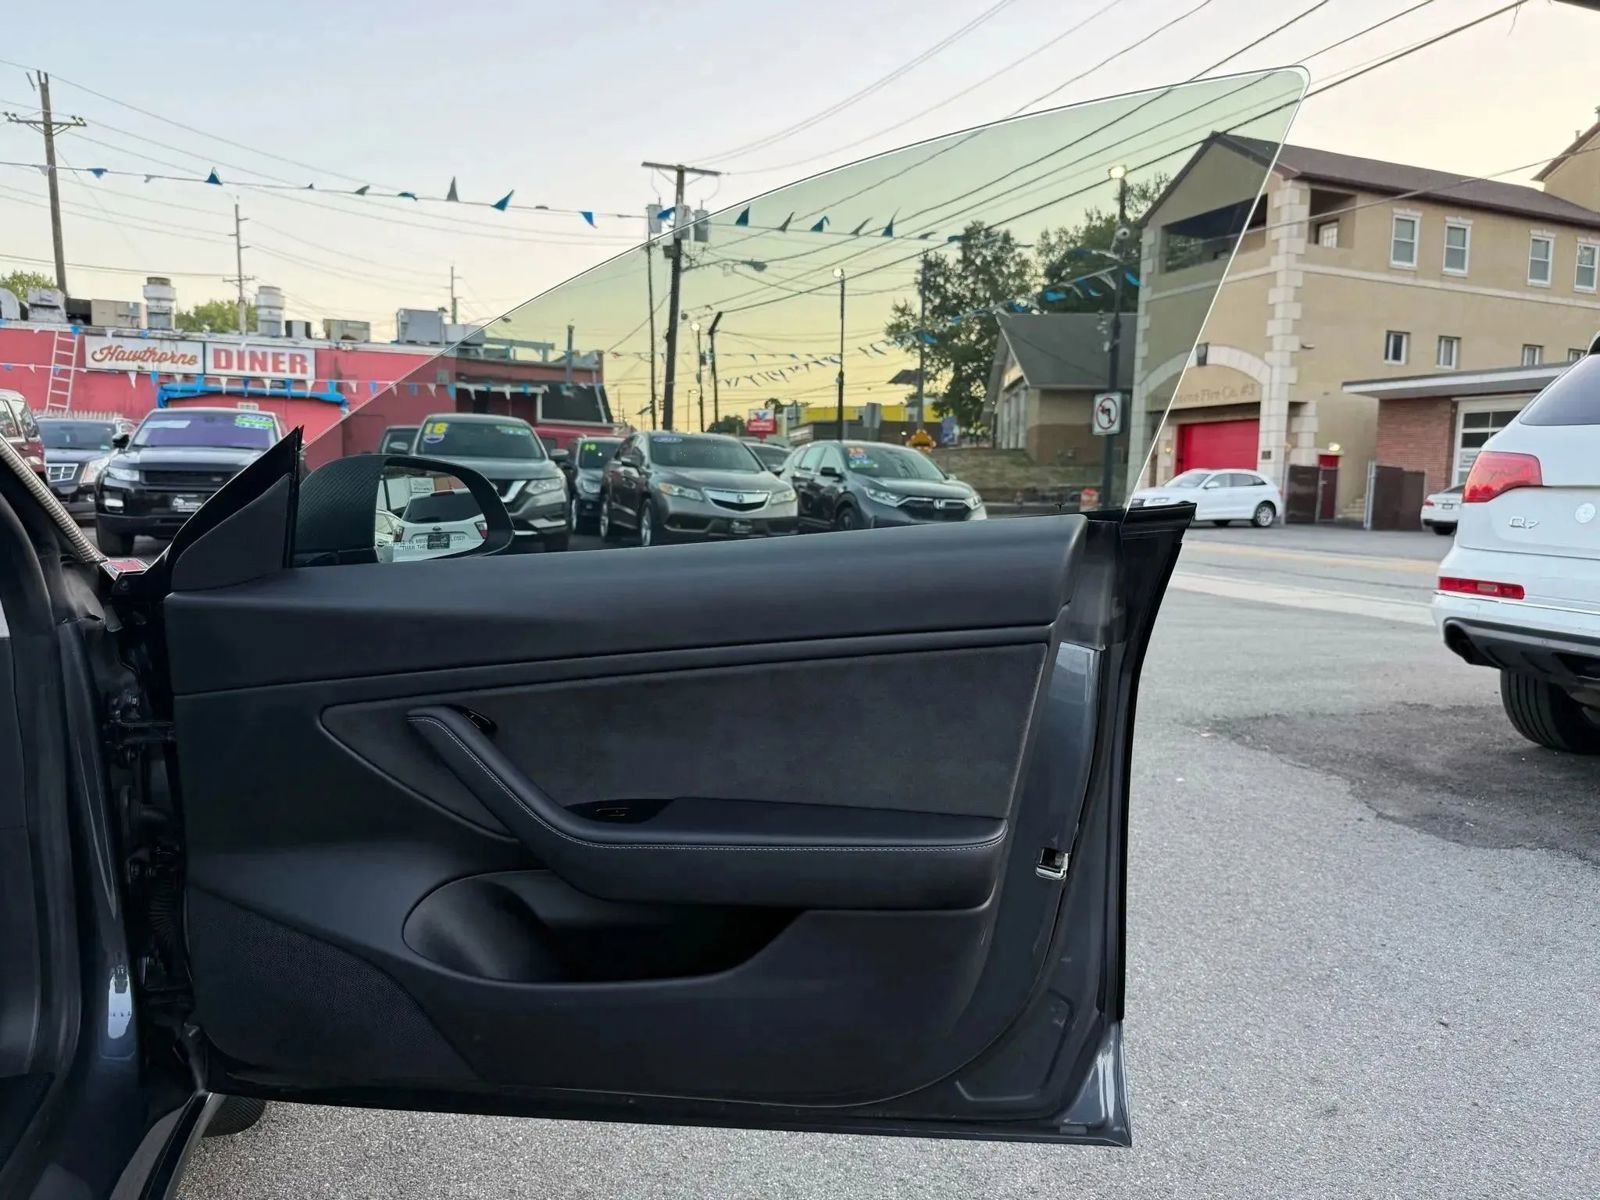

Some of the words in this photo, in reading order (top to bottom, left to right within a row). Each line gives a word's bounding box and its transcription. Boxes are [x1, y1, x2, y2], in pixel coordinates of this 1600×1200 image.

[91, 344, 198, 366] Hawthorne
[213, 347, 309, 375] DINER
[1509, 515, 1540, 529] Q7
